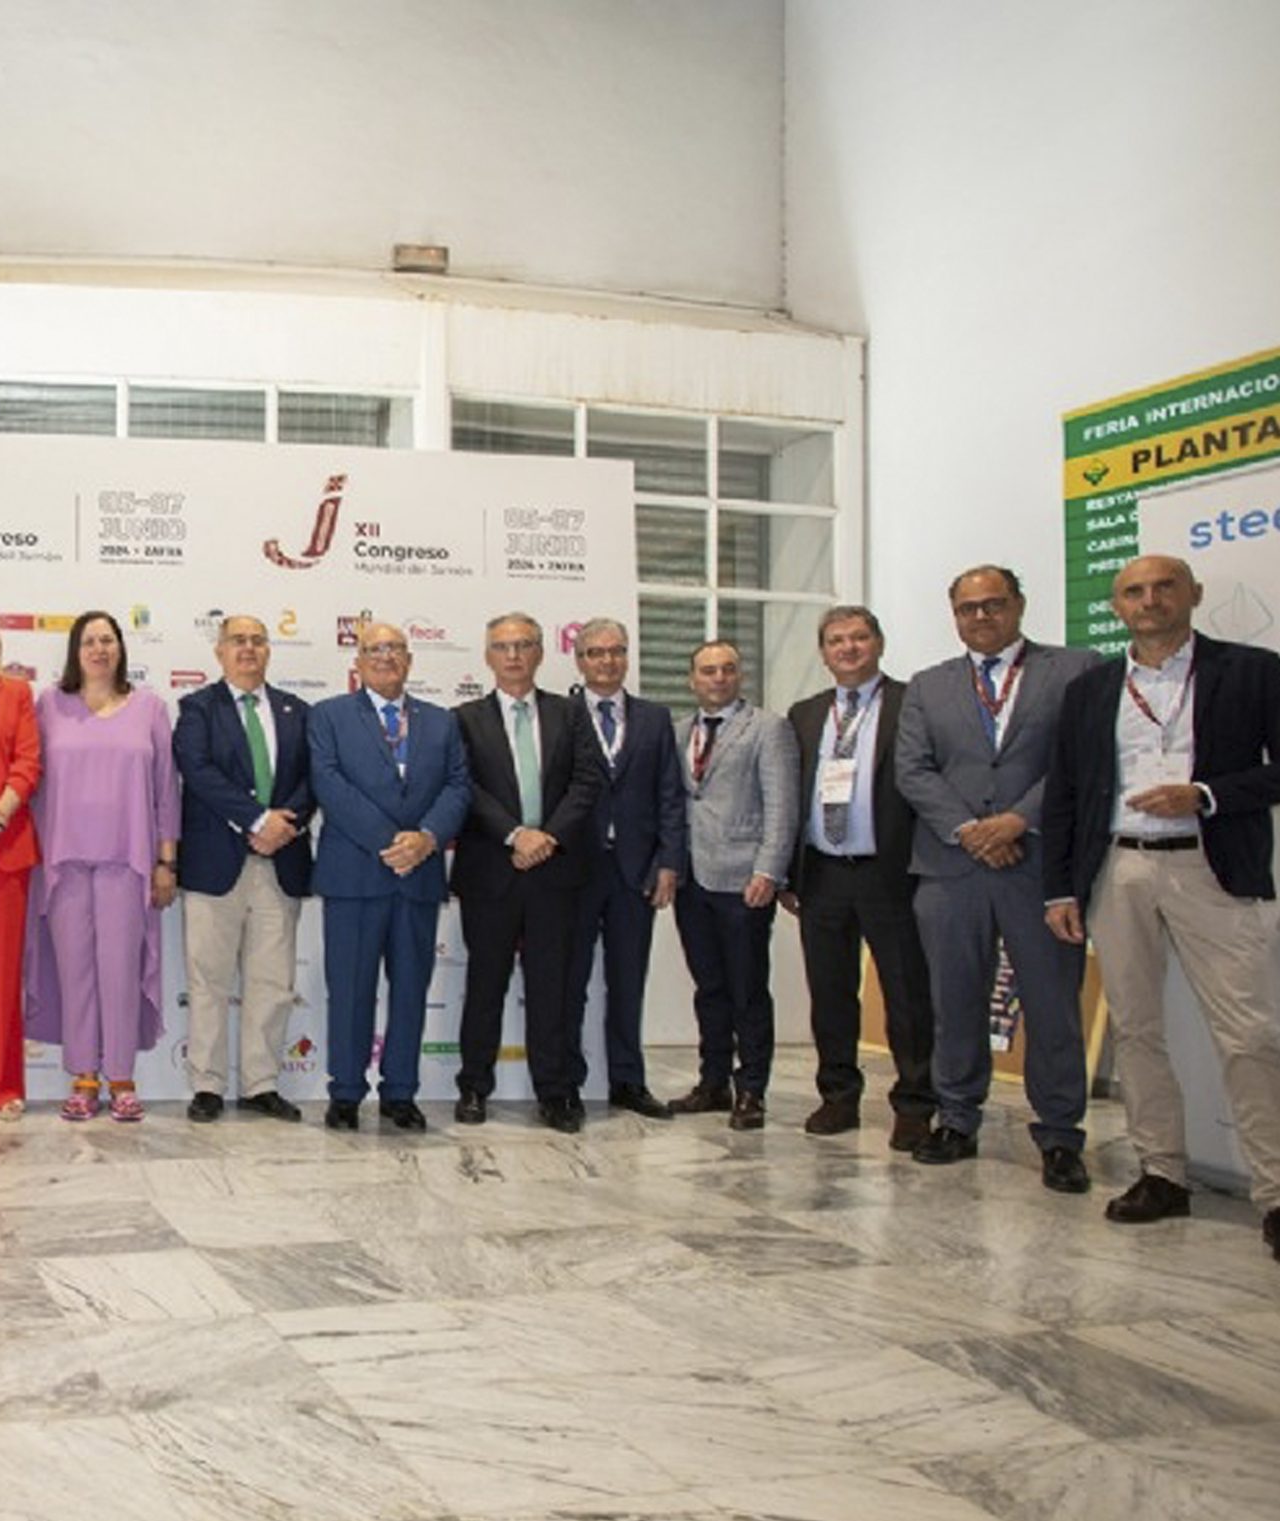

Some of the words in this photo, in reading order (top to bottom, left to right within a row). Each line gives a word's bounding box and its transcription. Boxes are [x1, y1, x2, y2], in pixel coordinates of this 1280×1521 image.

[1083, 415, 1139, 441] FERIA
[1145, 373, 1280, 425] INTERNACIO
[1131, 415, 1280, 475] PLANTA
[354, 521, 381, 537] XII
[1086, 514, 1126, 531] SALA
[1190, 508, 1280, 549] ste
[353, 540, 449, 562] Congreso
